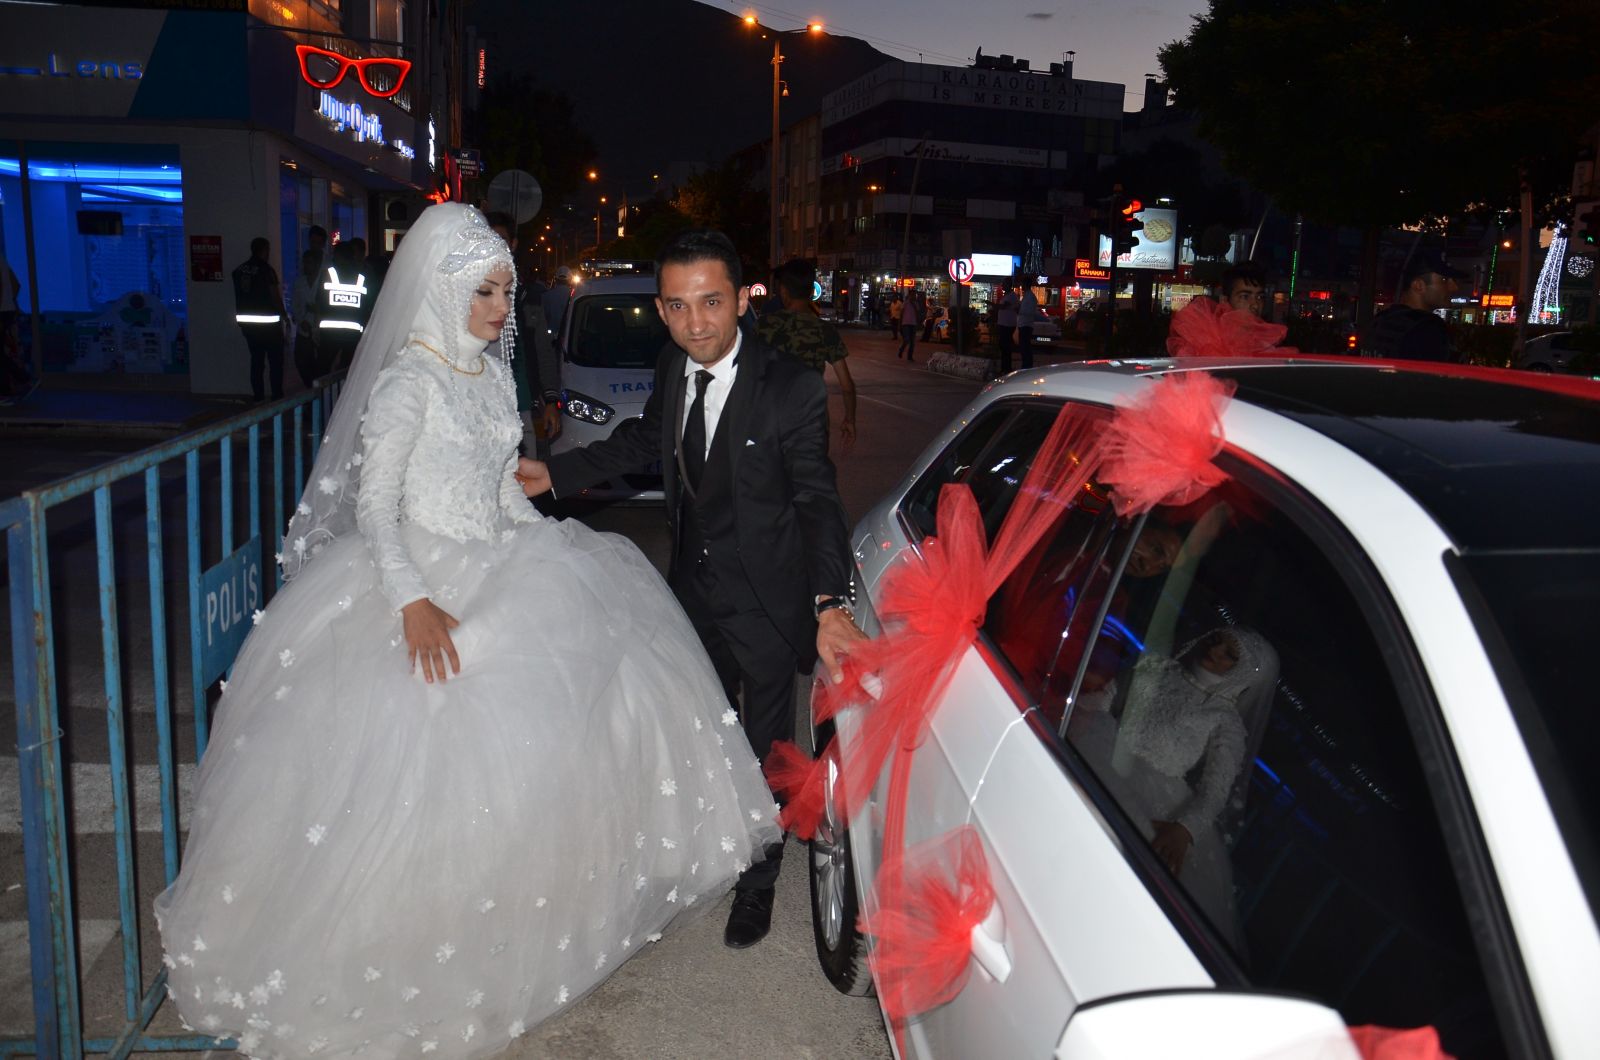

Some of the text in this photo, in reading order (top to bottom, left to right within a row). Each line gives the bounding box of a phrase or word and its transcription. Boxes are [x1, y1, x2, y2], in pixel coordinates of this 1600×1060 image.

[48, 51, 144, 80] Lens
[942, 70, 1085, 97] KARAOĞLAN
[974, 91, 1079, 113] MERKEZİ
[335, 293, 358, 304] POLİS
[609, 382, 656, 393] TRAF
[206, 555, 258, 647] POLİS
